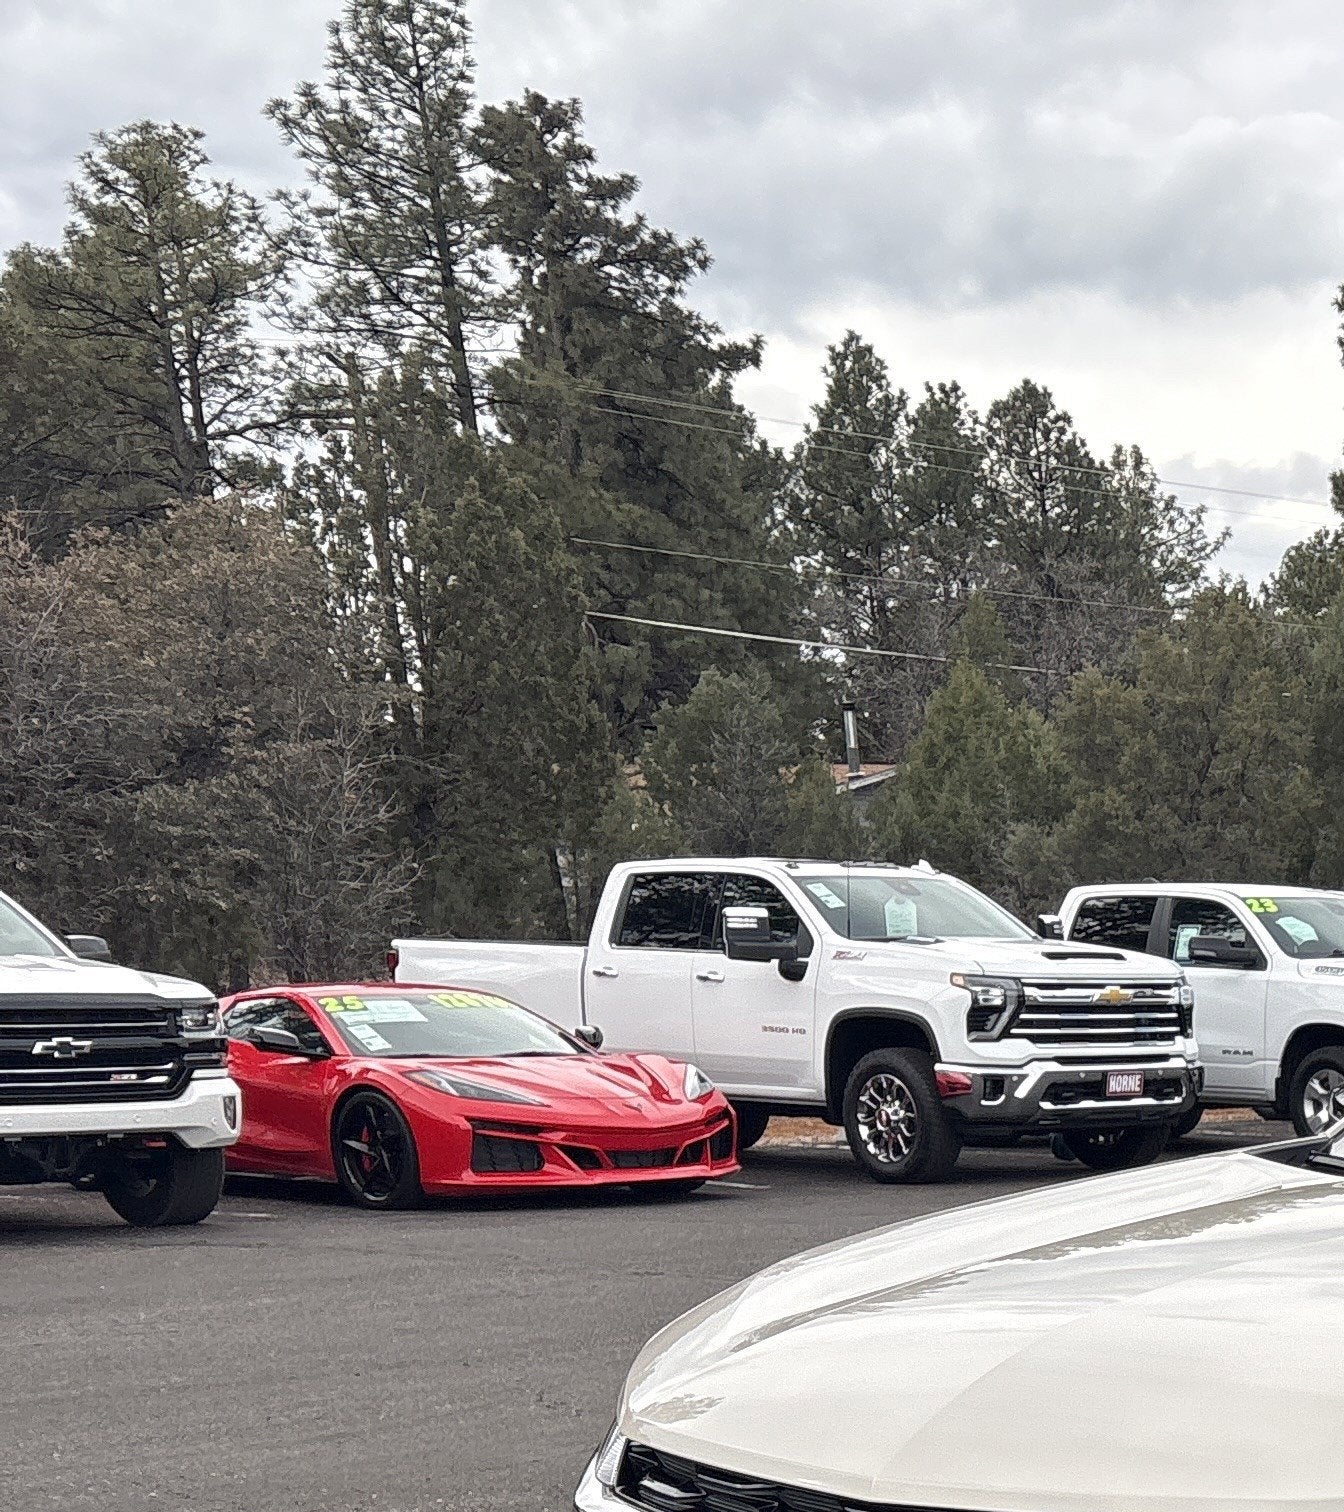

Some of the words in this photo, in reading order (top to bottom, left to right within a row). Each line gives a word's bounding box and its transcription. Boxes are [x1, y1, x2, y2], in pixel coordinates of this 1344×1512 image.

[1245, 898, 1279, 913] 23
[318, 995, 365, 1012] 25
[1108, 1074, 1142, 1092] HORNE
